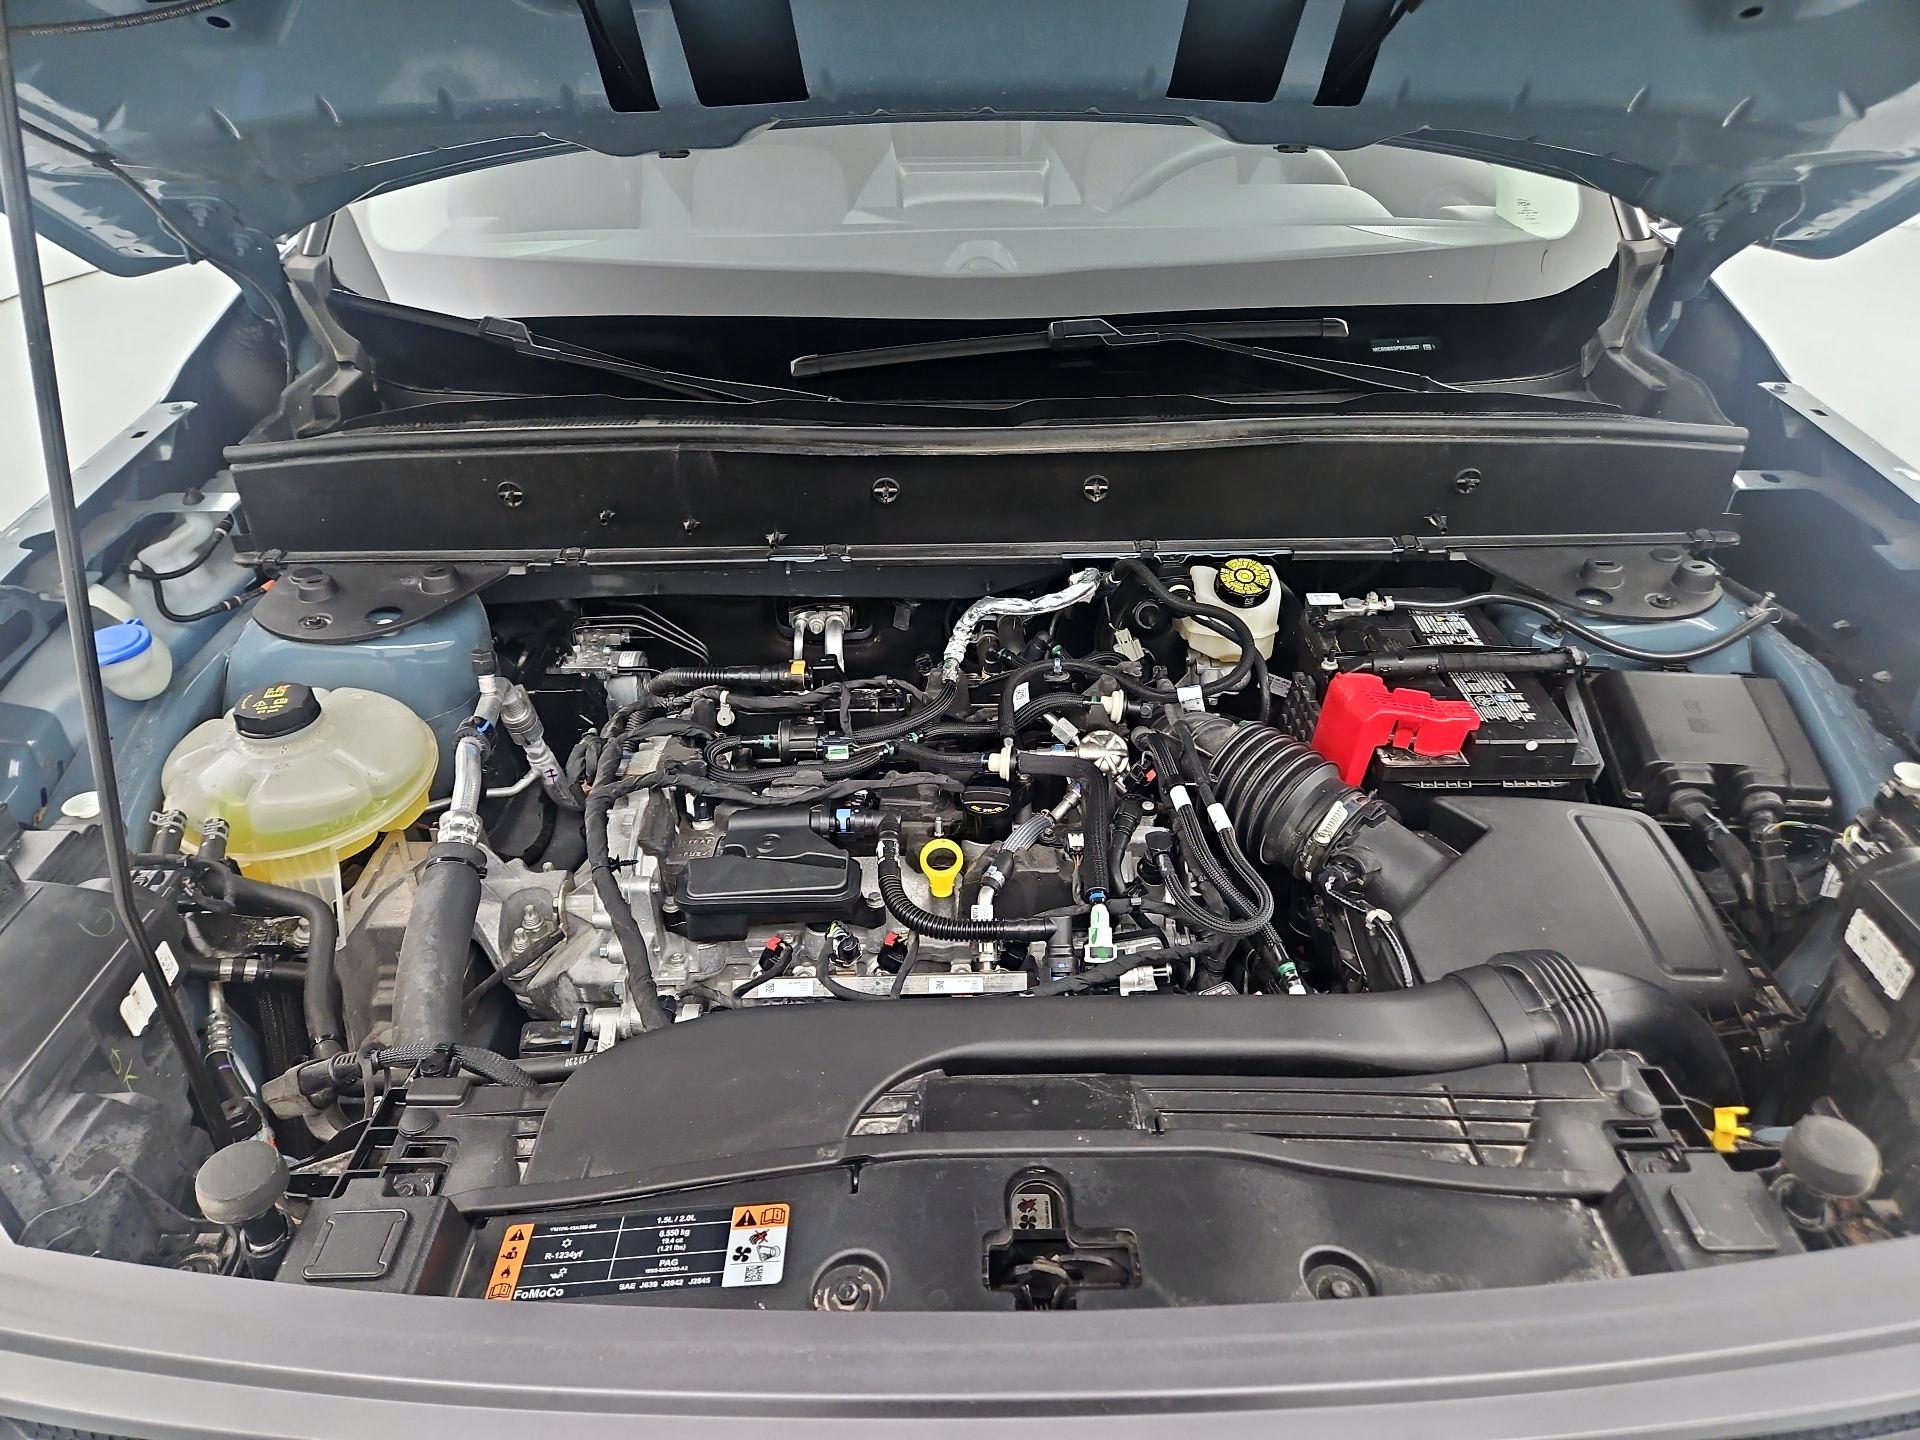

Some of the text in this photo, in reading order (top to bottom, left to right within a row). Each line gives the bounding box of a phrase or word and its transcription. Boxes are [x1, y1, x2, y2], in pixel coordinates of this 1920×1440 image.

[656, 1215, 674, 1224] 1.5L
[679, 1214, 697, 1222] 2.0L
[658, 1228, 691, 1238] 0.550 kg
[656, 1243, 687, 1254] (1.21 lbs)
[544, 1249, 584, 1261] R-1234yf
[658, 1258, 679, 1267] PAG
[618, 1276, 711, 1291] SAE J639 J2842 J2845
[513, 1287, 564, 1300] FoMoCo
